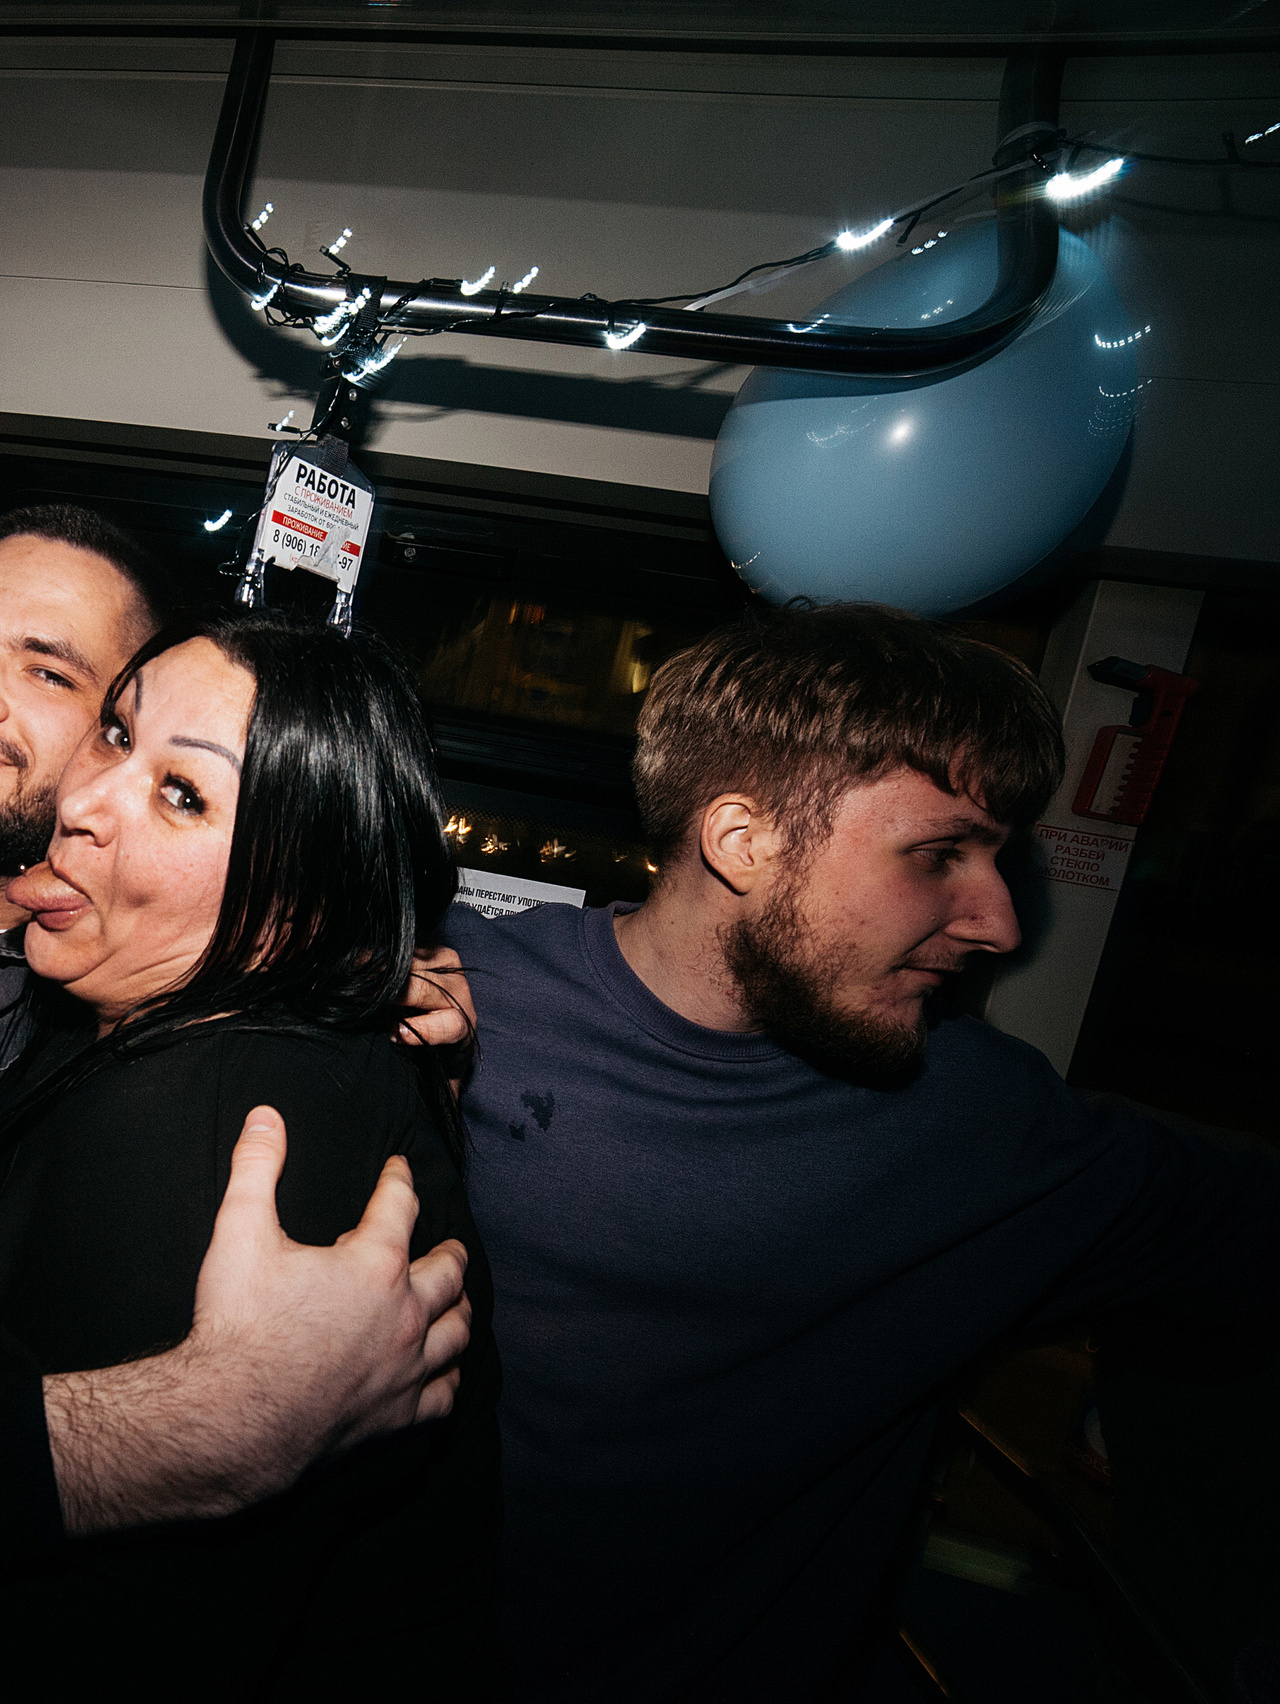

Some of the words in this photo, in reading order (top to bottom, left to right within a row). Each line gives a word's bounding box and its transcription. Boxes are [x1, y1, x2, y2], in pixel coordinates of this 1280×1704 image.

[295, 463, 357, 509] РАБОТА
[283, 493, 320, 514] СТАБИЛЬНЫЙ
[324, 509, 359, 531] ЕЖЕДНЕВНЫЙ
[295, 485, 301, 496] С
[301, 488, 353, 519] ПРОЖИВАНИЕМ
[287, 505, 318, 524] ЗАРАБОТОК
[273, 529, 280, 543] 8
[281, 532, 307, 555] (906)
[1039, 829, 1067, 842] ПРИ
[1070, 835, 1129, 852] АВАРИИ
[1055, 844, 1105, 861] РАЗБЕЙ
[1050, 856, 1100, 872] СТЕКЛО
[1039, 866, 1109, 886] МОЛОТКОМ
[475, 888, 517, 905] ПЕРЕСТАЮТ
